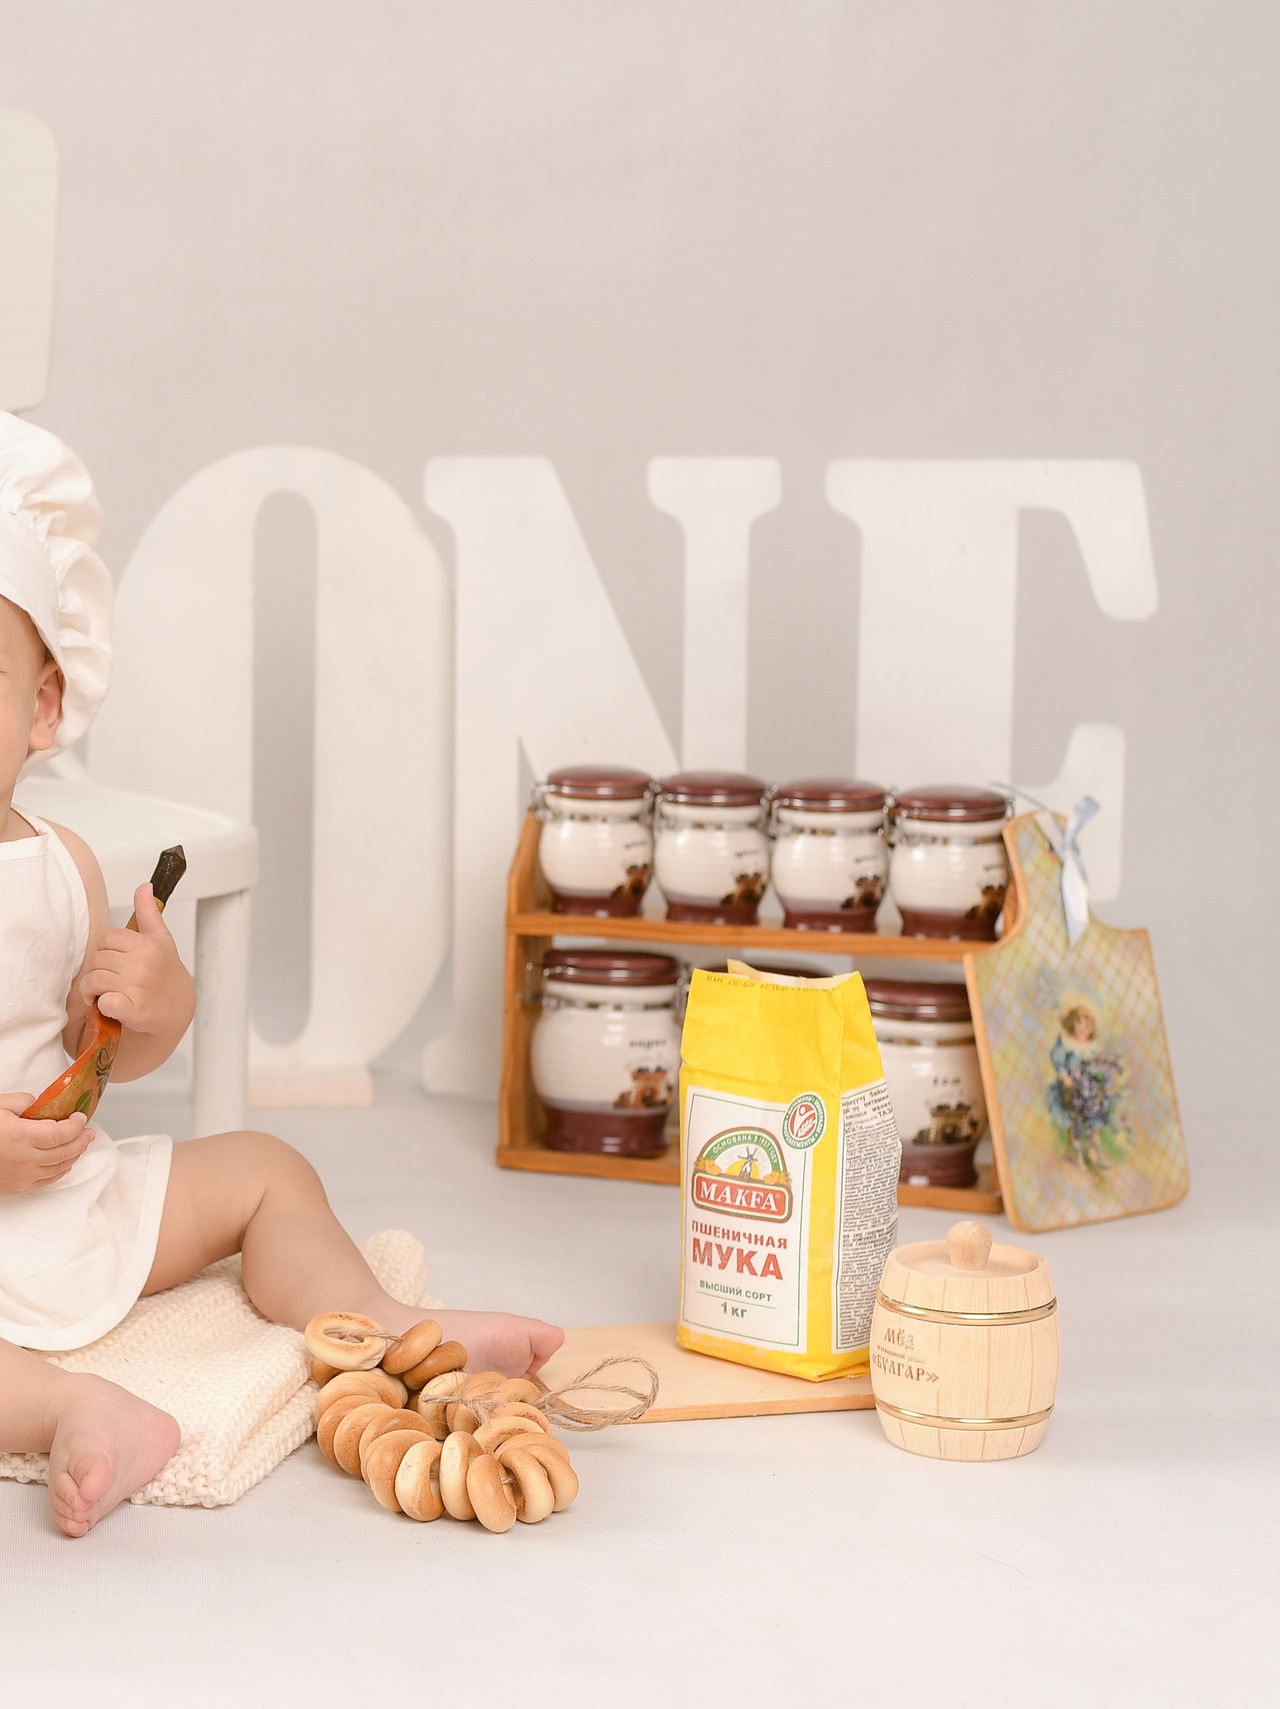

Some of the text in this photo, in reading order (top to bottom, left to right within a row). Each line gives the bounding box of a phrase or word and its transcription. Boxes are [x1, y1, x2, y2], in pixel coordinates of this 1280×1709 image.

[87, 445, 1158, 1098] ONE
[712, 1134, 751, 1153] ОСНОВАНА
[768, 1146, 778, 1163] ГОДУ
[700, 1181, 778, 1212] MAKFA
[691, 1220, 788, 1250] ПШЕНИЧНАЯ
[692, 1237, 783, 1280] МУКА
[699, 1280, 773, 1302] ВЫСШИЙ СОРТ
[721, 1302, 728, 1315] 1
[884, 1328, 914, 1350] МЁД
[872, 1353, 939, 1383] «БУЛГАР»
